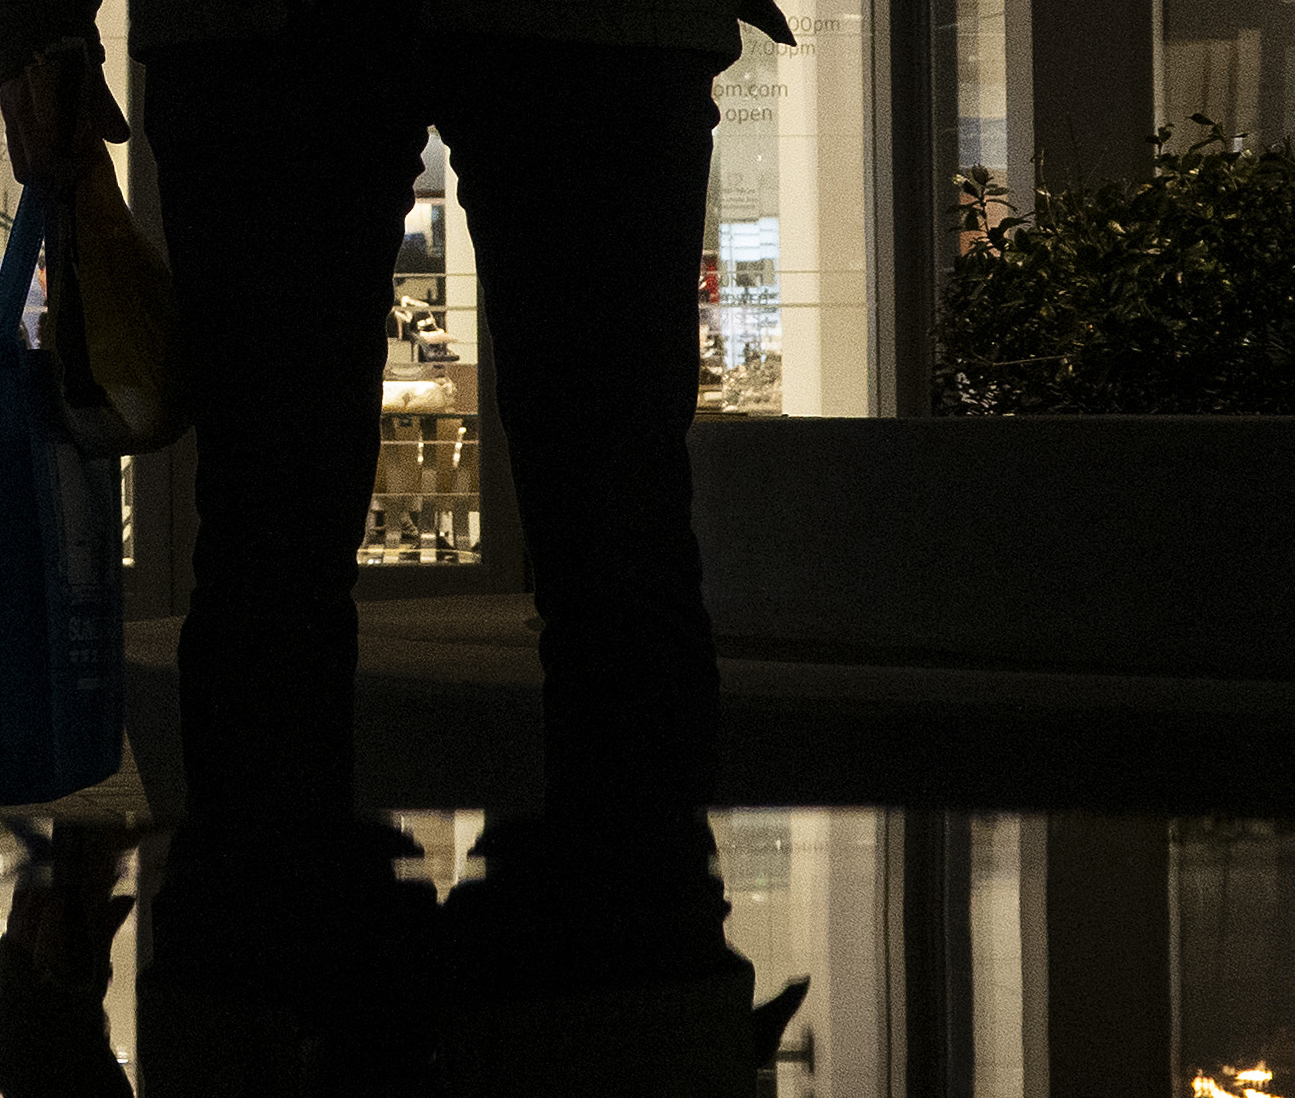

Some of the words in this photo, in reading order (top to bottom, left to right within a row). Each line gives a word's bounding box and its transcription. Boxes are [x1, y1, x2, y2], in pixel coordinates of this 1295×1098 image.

[789, 16, 840, 34] 00pm
[712, 83, 789, 99] om.com
[725, 106, 773, 124] open
